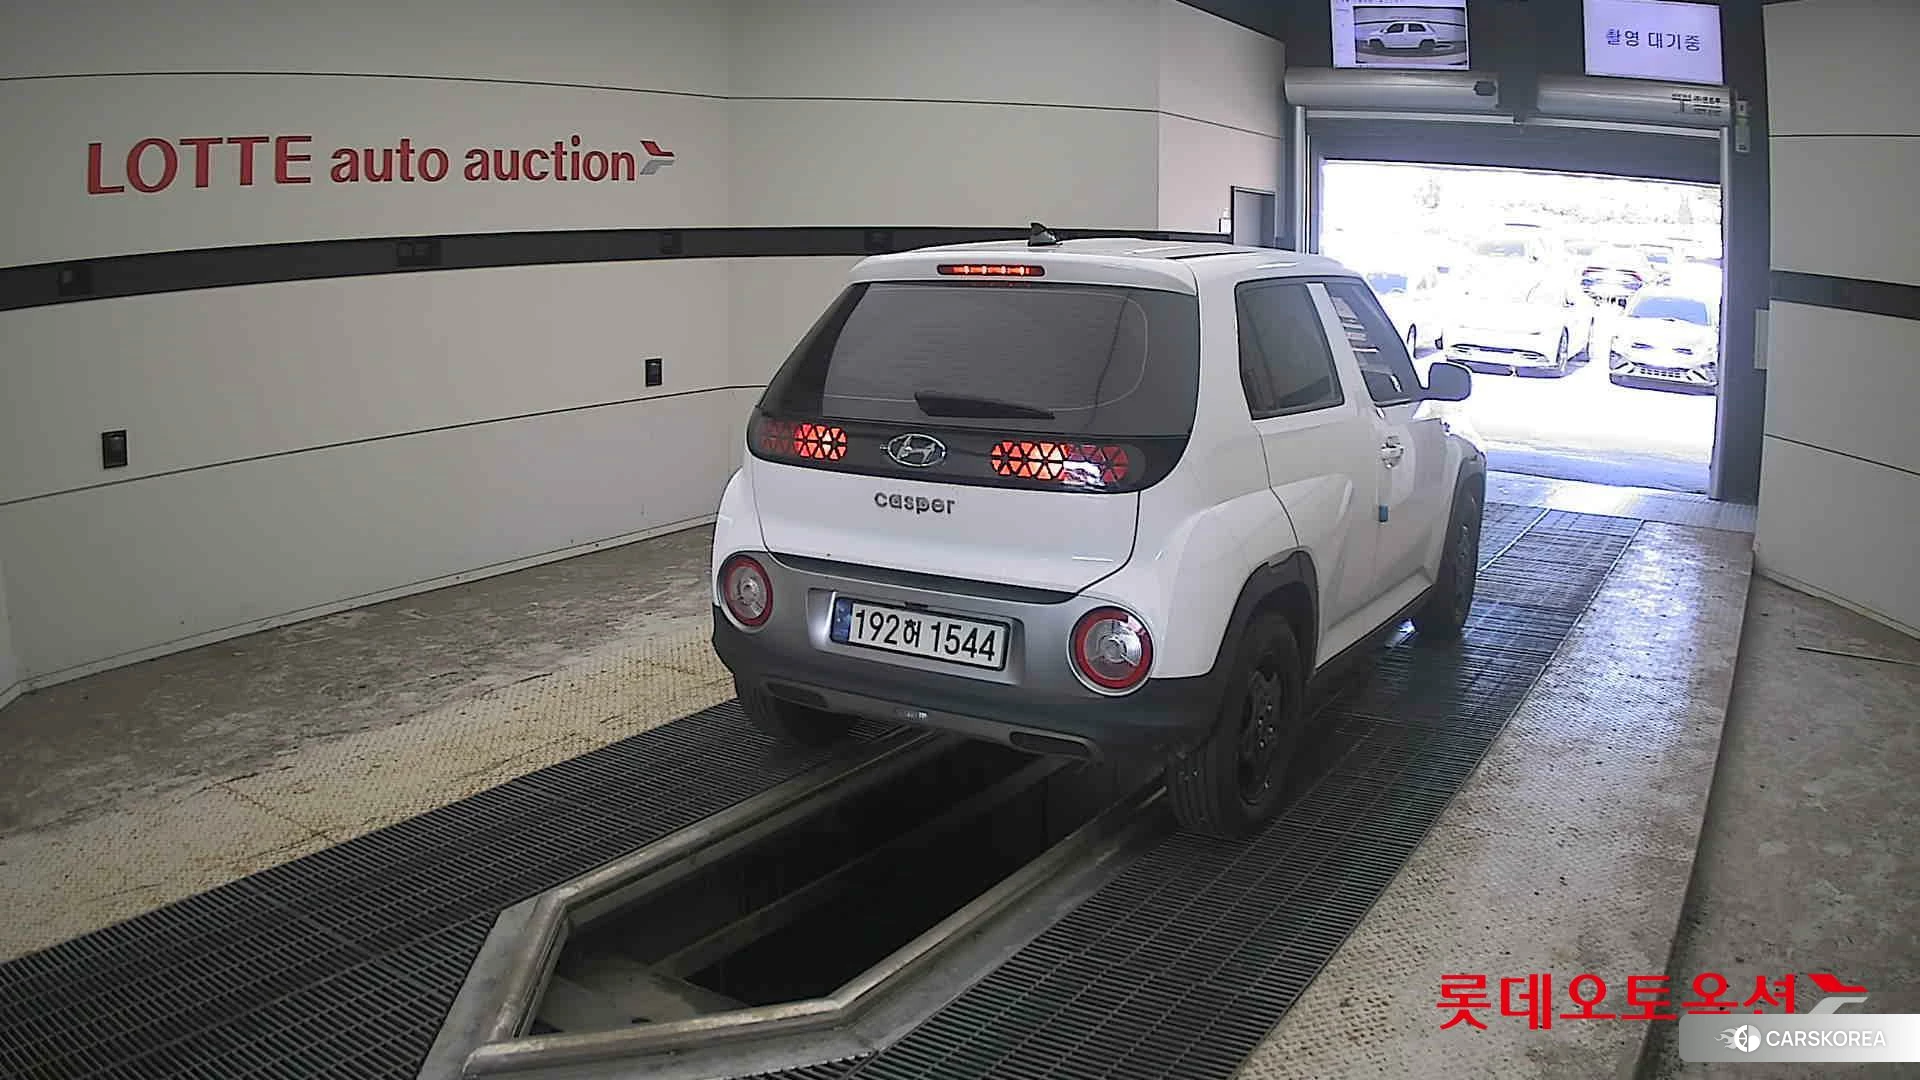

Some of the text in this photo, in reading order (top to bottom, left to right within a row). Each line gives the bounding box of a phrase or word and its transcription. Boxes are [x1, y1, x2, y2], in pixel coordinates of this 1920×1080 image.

[1648, 31, 1701, 52] 대기중
[88, 134, 637, 195] LOTTE auto auction
[874, 492, 956, 514] casper
[855, 609, 996, 661] 192허 1544
